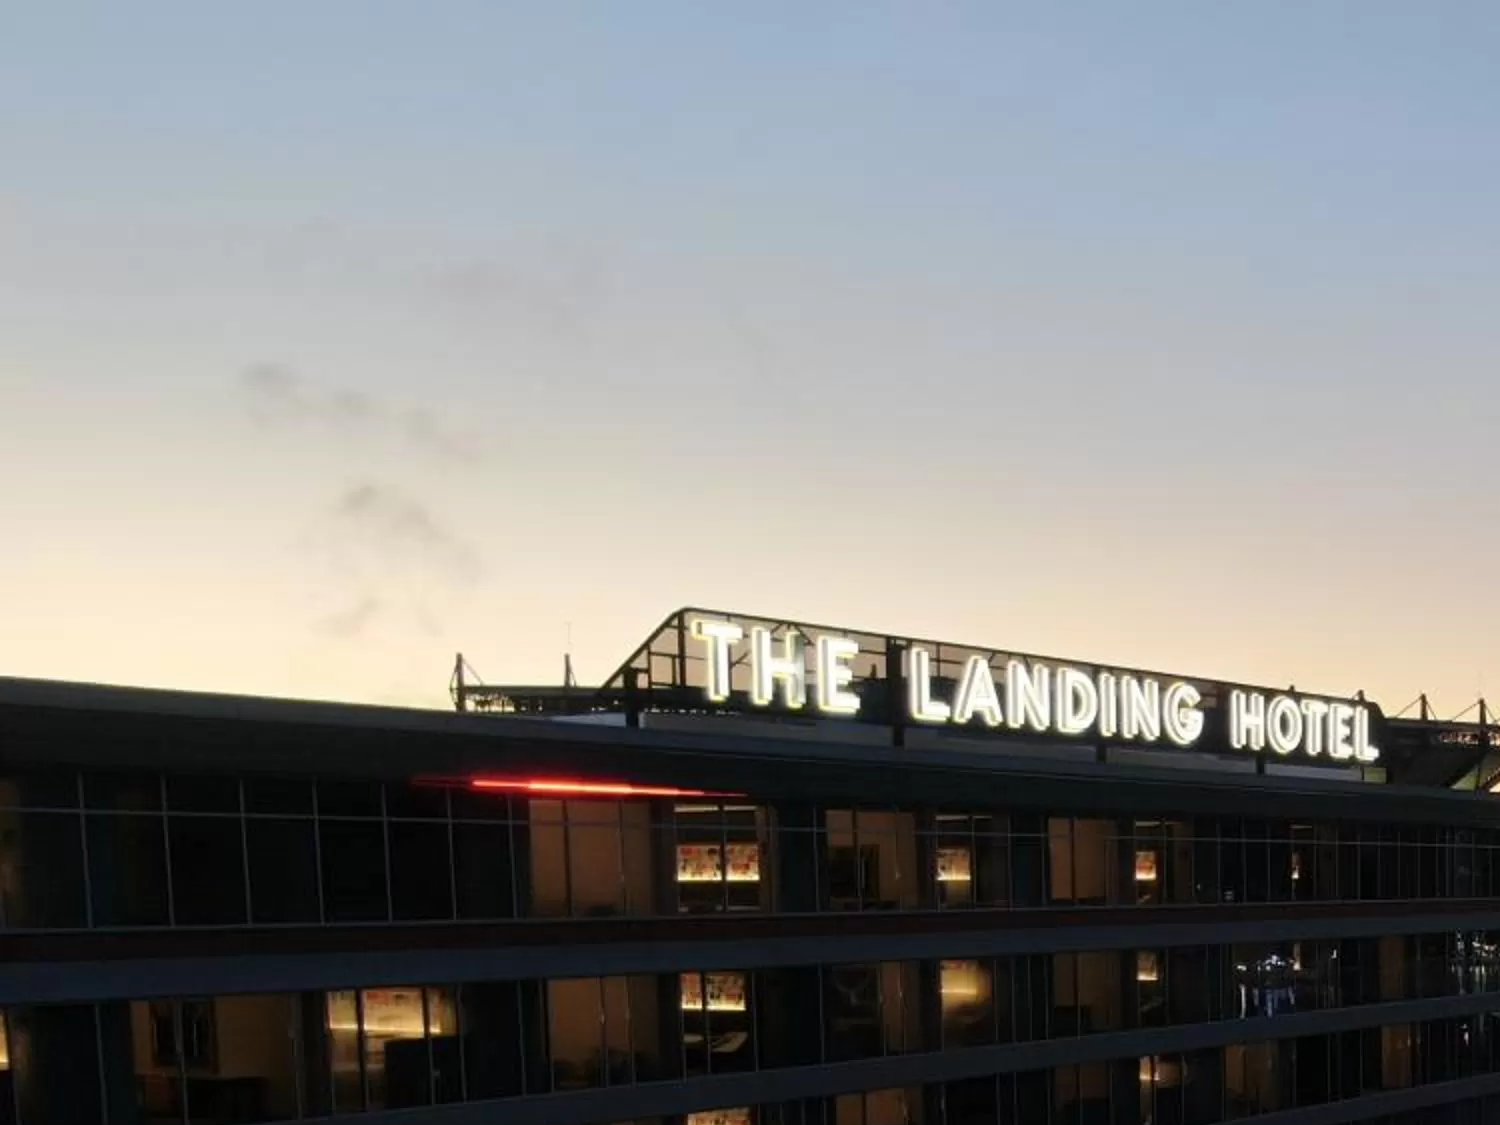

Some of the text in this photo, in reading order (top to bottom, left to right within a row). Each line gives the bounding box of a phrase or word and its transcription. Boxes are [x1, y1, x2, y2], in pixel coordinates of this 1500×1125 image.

[691, 619, 1380, 762] THE LANDING HOTEL
